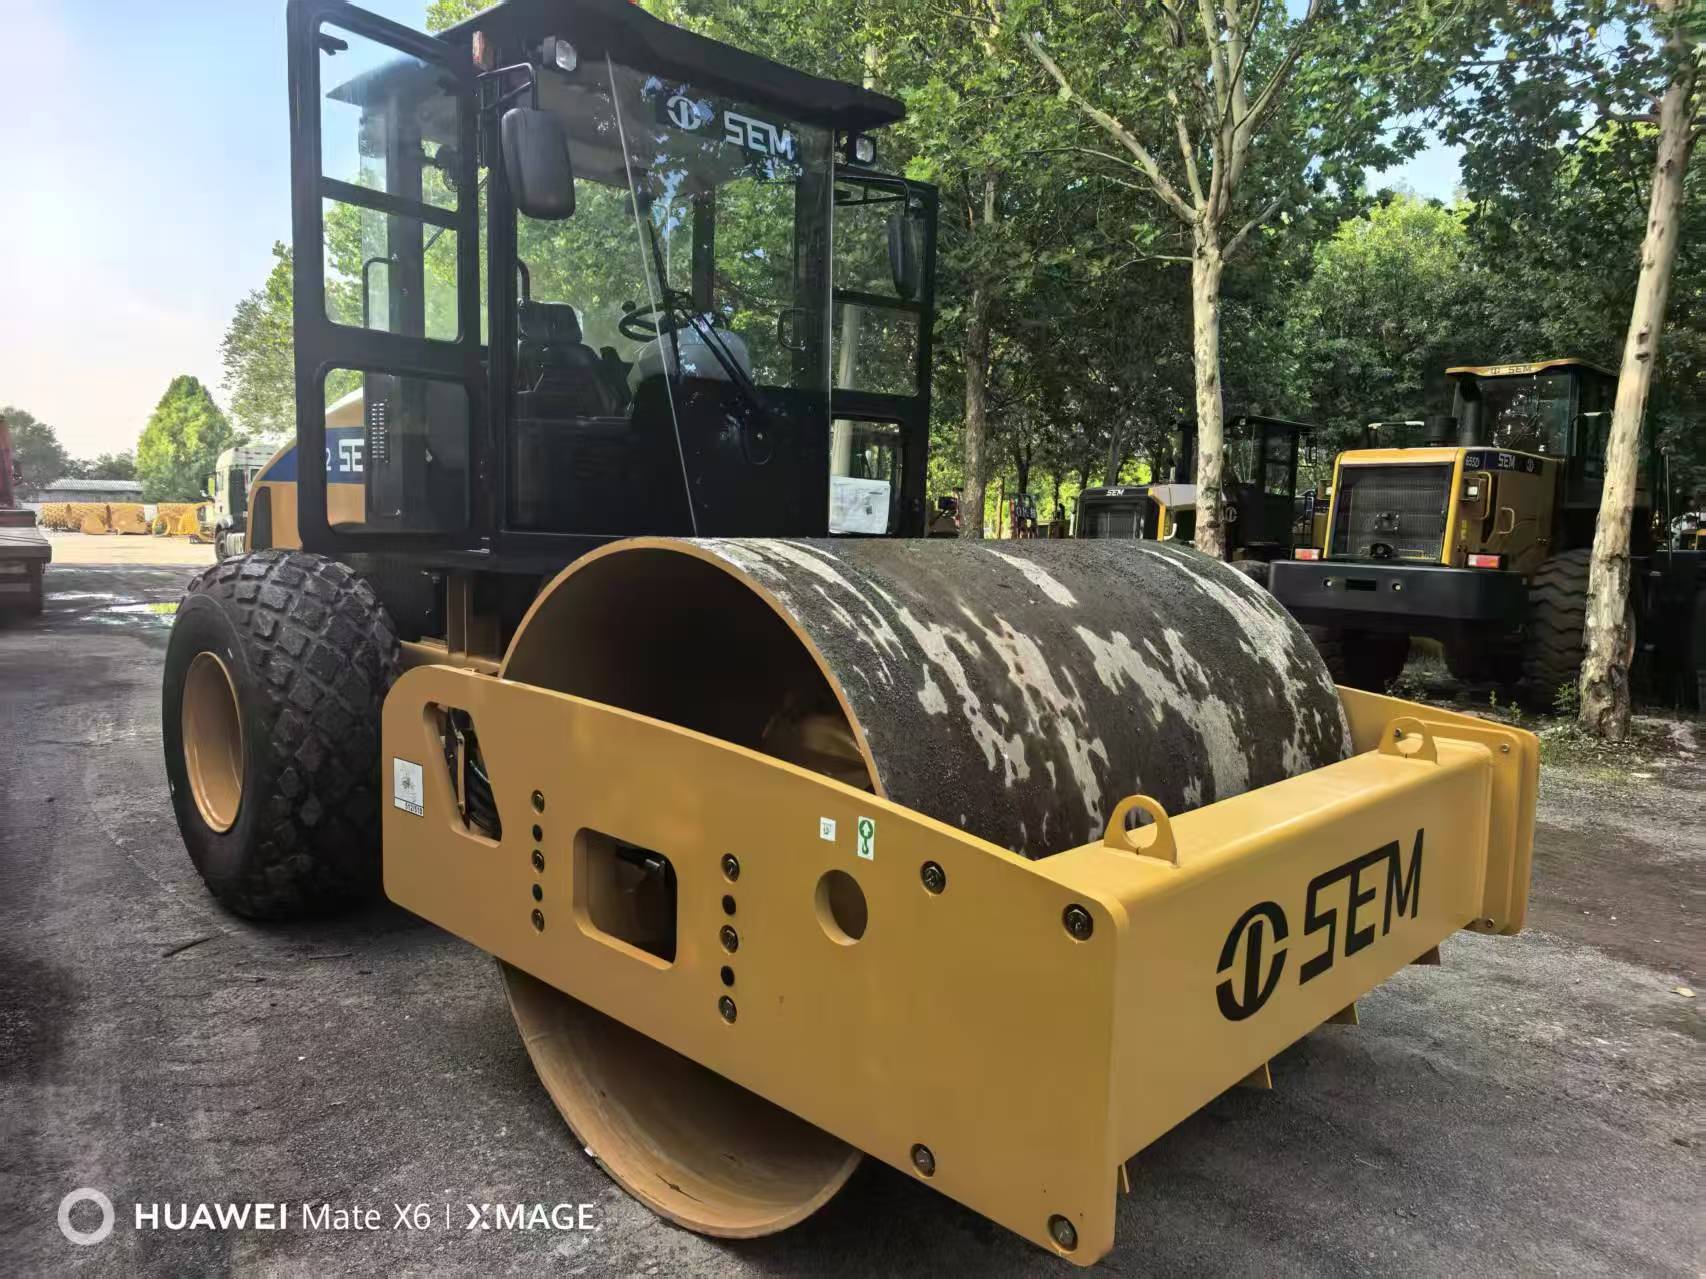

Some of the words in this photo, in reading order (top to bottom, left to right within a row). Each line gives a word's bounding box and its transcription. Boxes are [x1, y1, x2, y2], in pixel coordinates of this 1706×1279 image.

[723, 110, 795, 161] SEM
[1508, 366, 1532, 374] SEM
[338, 438, 365, 472] SE
[1498, 453, 1516, 469] SEM
[1106, 488, 1125, 497] SEM
[1299, 827, 1425, 987] SEM
